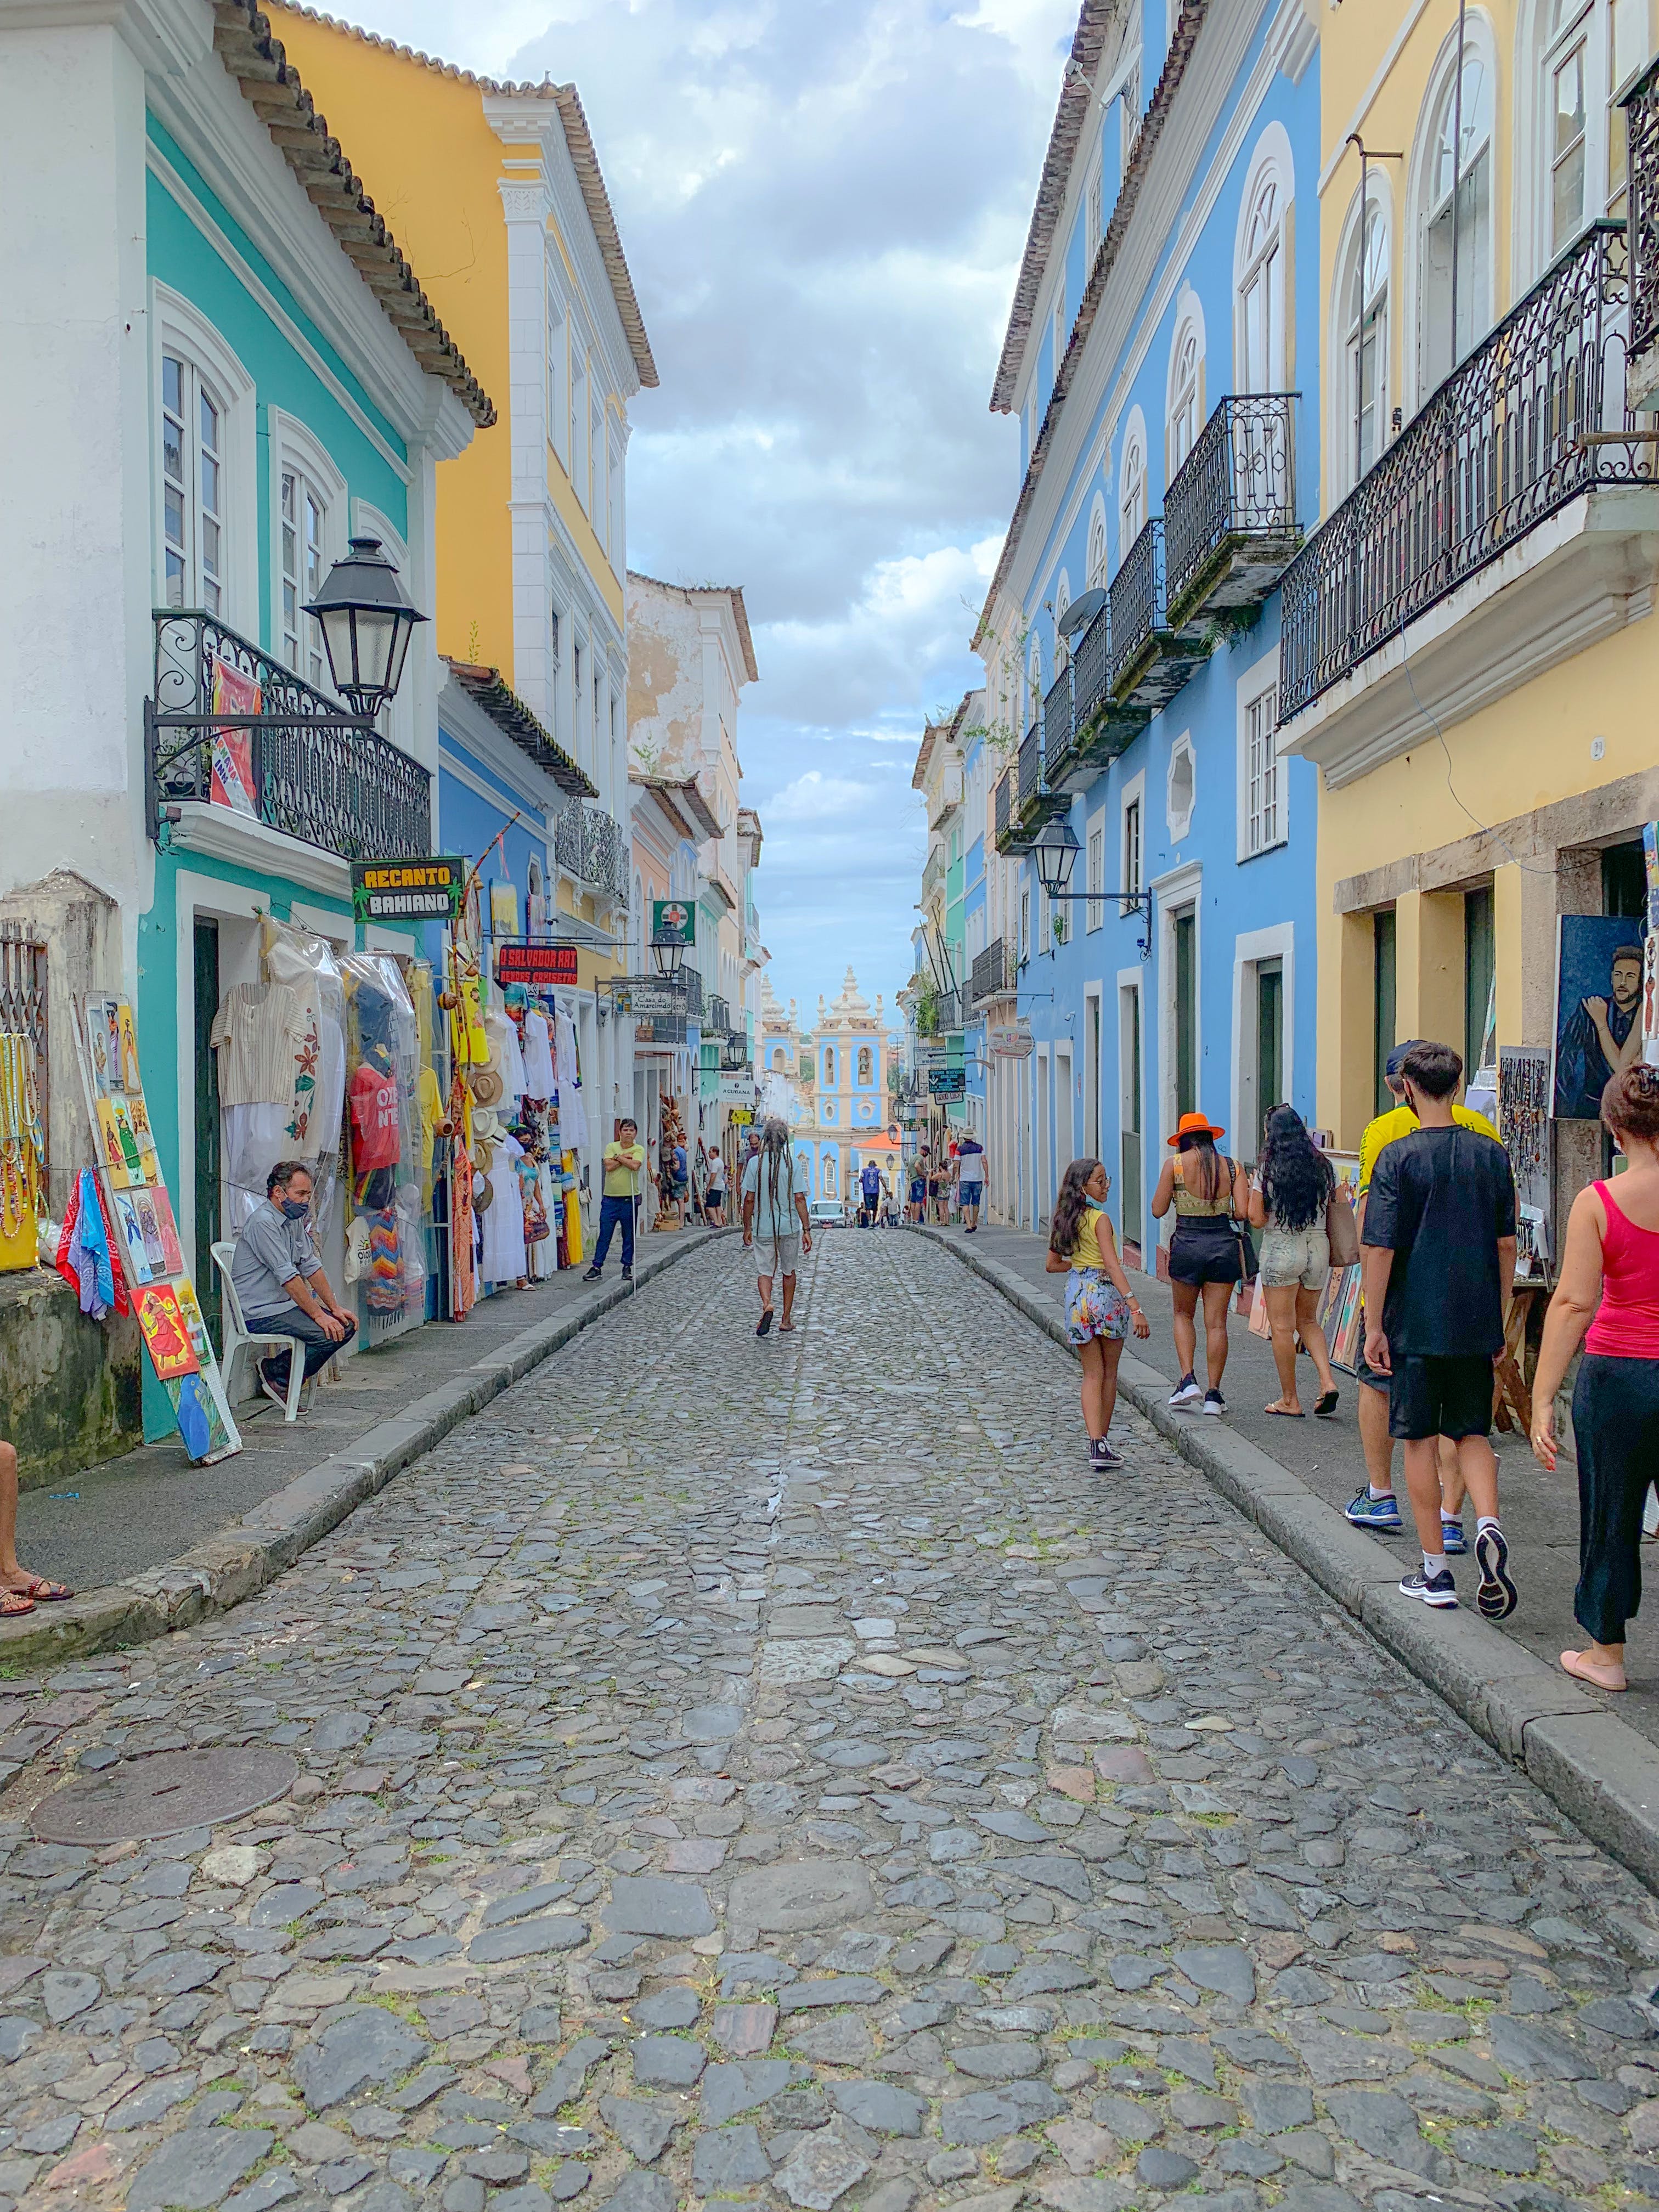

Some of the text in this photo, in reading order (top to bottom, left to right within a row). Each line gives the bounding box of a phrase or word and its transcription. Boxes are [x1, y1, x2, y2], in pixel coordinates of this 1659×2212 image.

[215, 759, 228, 785] INN
[364, 867, 450, 889] RECANTO
[370, 893, 449, 915] BAHIANO
[508, 949, 557, 968] SALVADOR
[557, 950, 577, 968] ART
[532, 972, 577, 985] CAMISETAS
[376, 1087, 399, 1107] OXE
[378, 1108, 399, 1128] NTE
